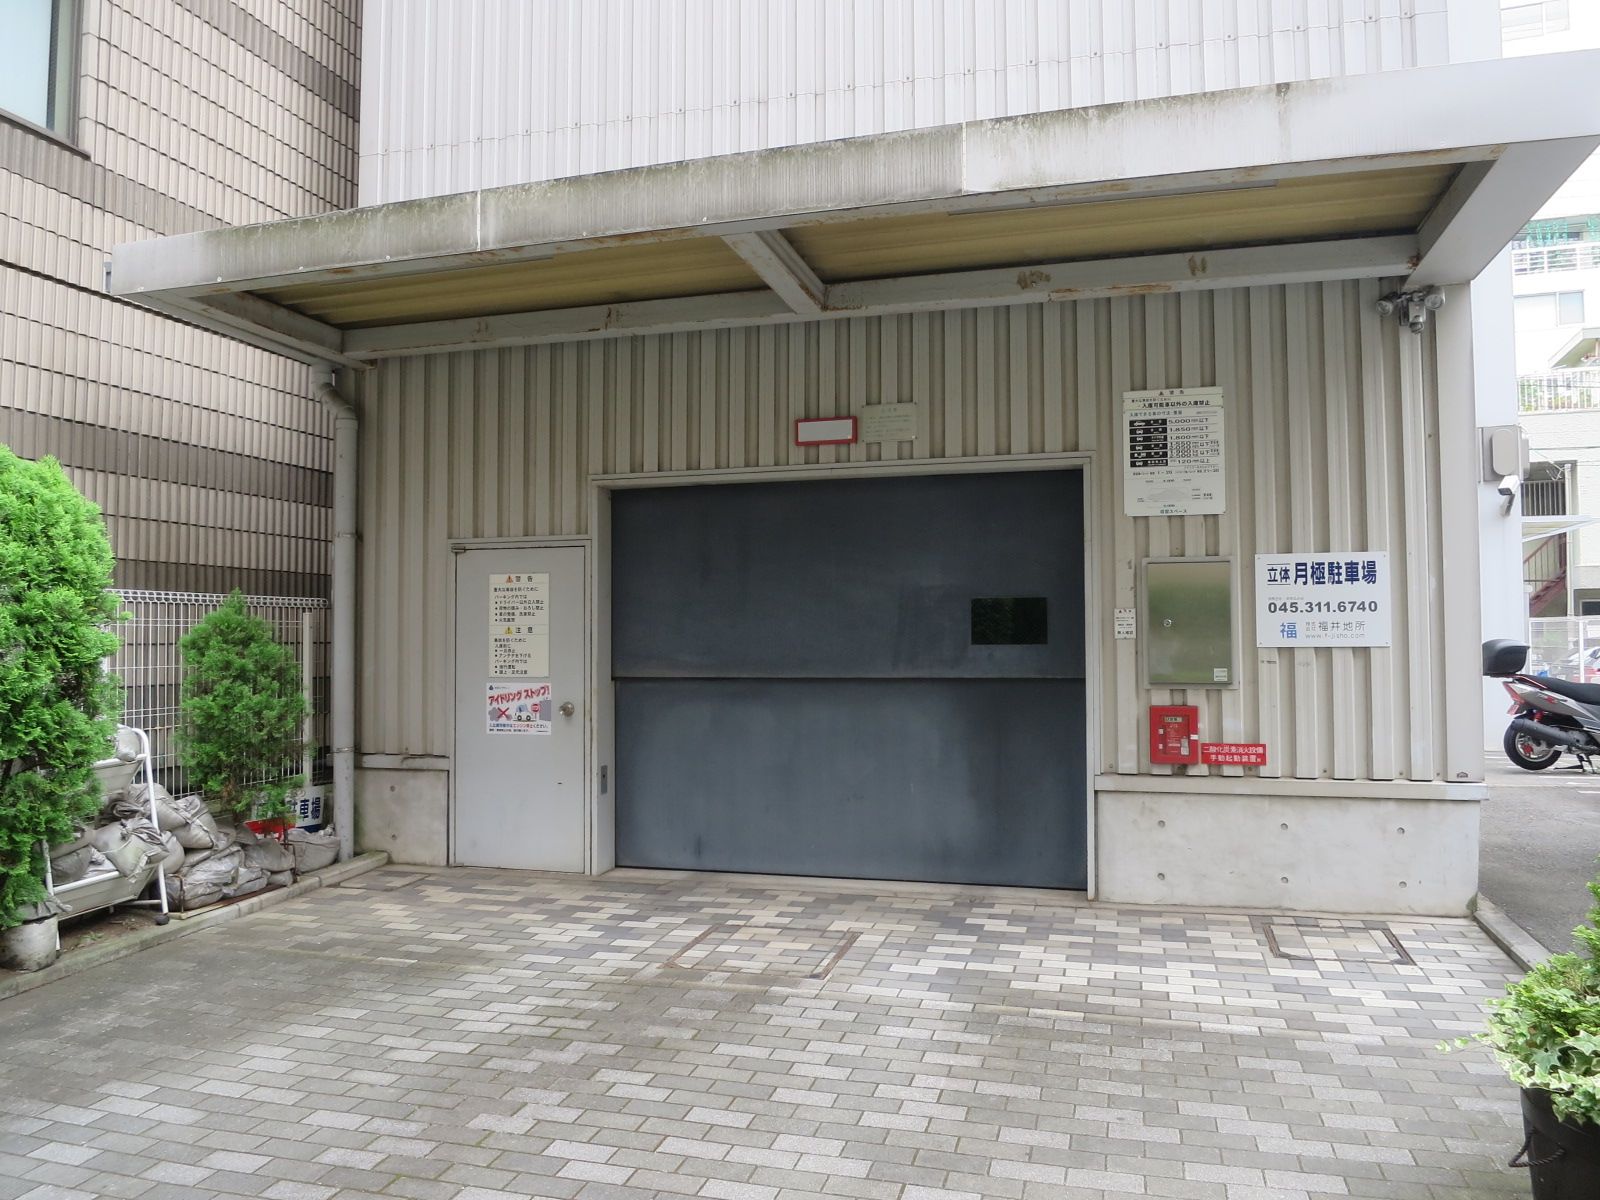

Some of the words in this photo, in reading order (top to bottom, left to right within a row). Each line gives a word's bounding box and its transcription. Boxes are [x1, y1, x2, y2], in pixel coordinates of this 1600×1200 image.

[1267, 567, 1291, 583] 立体
[1294, 560, 1377, 586] 月極駐車場
[1268, 601, 1378, 614] 045.311.6740
[1280, 622, 1298, 639] 福
[1318, 621, 1366, 632] 福井地所
